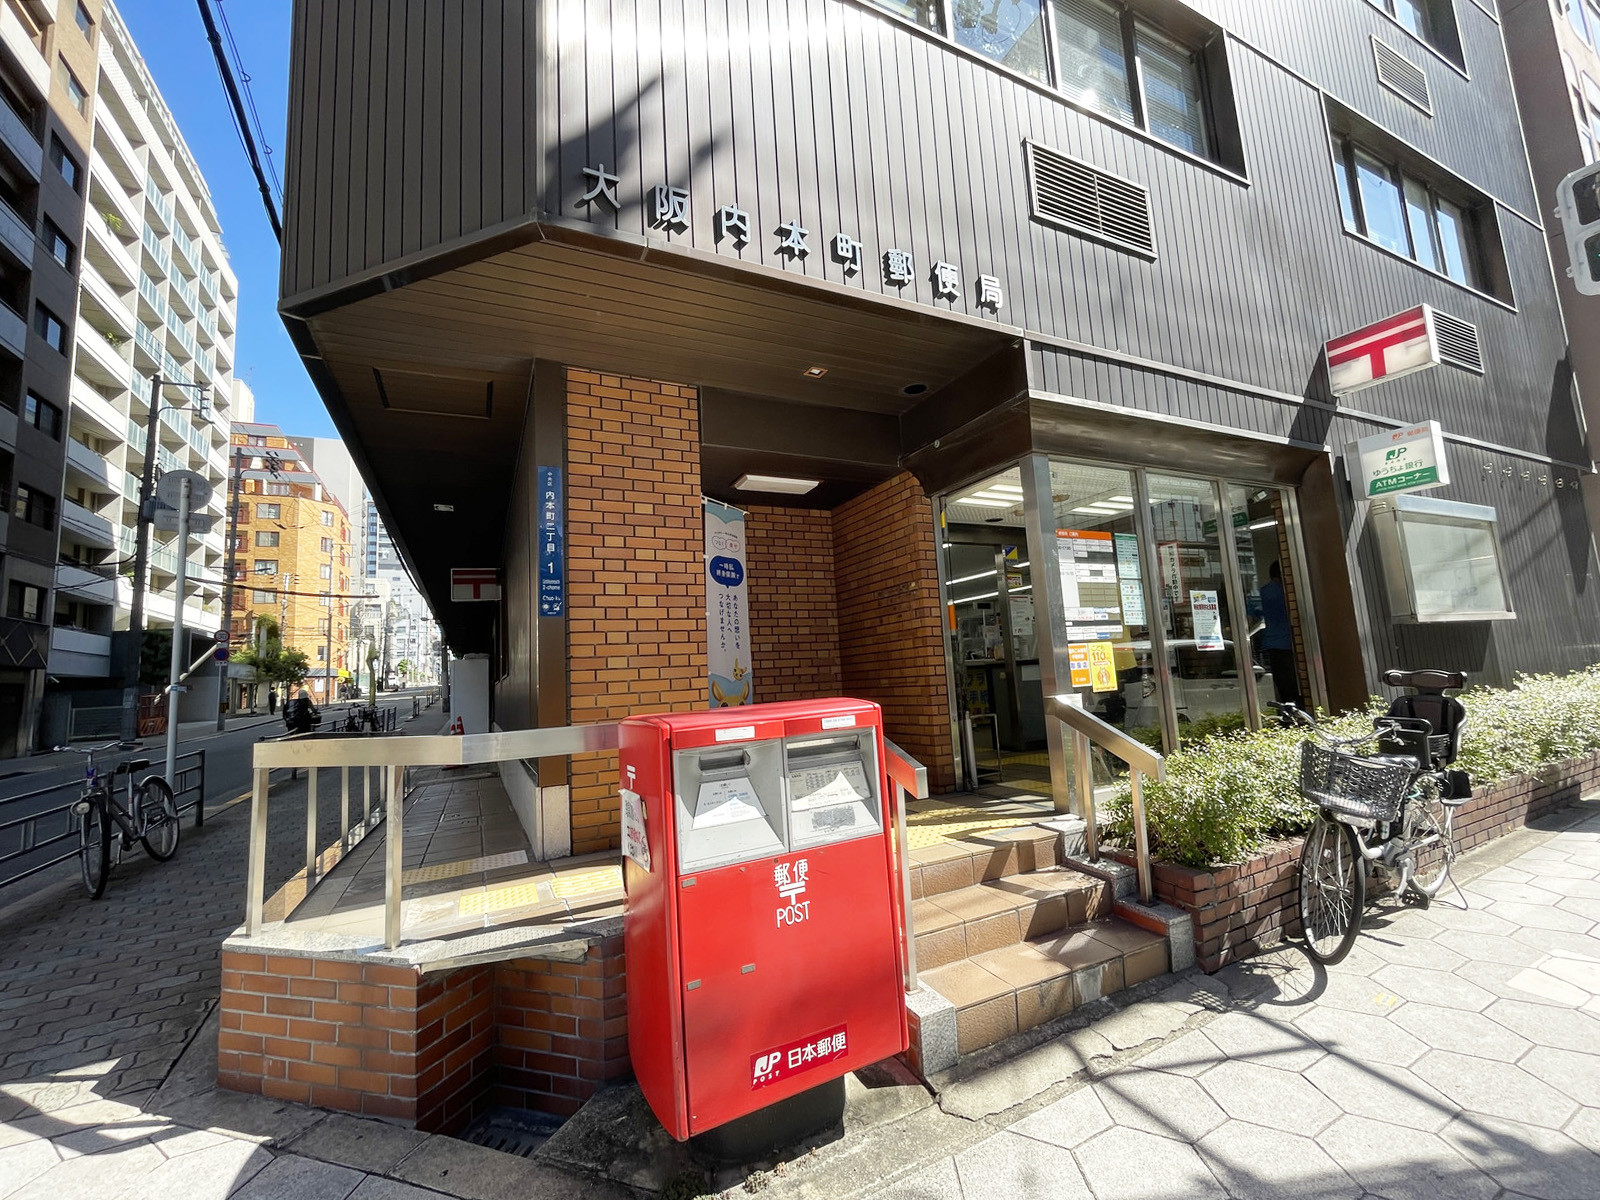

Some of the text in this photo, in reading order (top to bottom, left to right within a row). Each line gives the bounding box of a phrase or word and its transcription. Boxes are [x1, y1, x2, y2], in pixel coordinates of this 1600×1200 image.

[583, 163, 1003, 308] 大阪内本町郵便局
[1373, 459, 1423, 477] ゆうちょ銀行
[545, 490, 555, 552] 内本町二丁目
[725, 594, 733, 633] 大切な人へ
[733, 594, 741, 650] あなたの想いを
[773, 858, 809, 887] 郵便
[776, 901, 811, 928] POST
[787, 1032, 847, 1069] 日本郵便
[752, 1070, 781, 1086] POST
